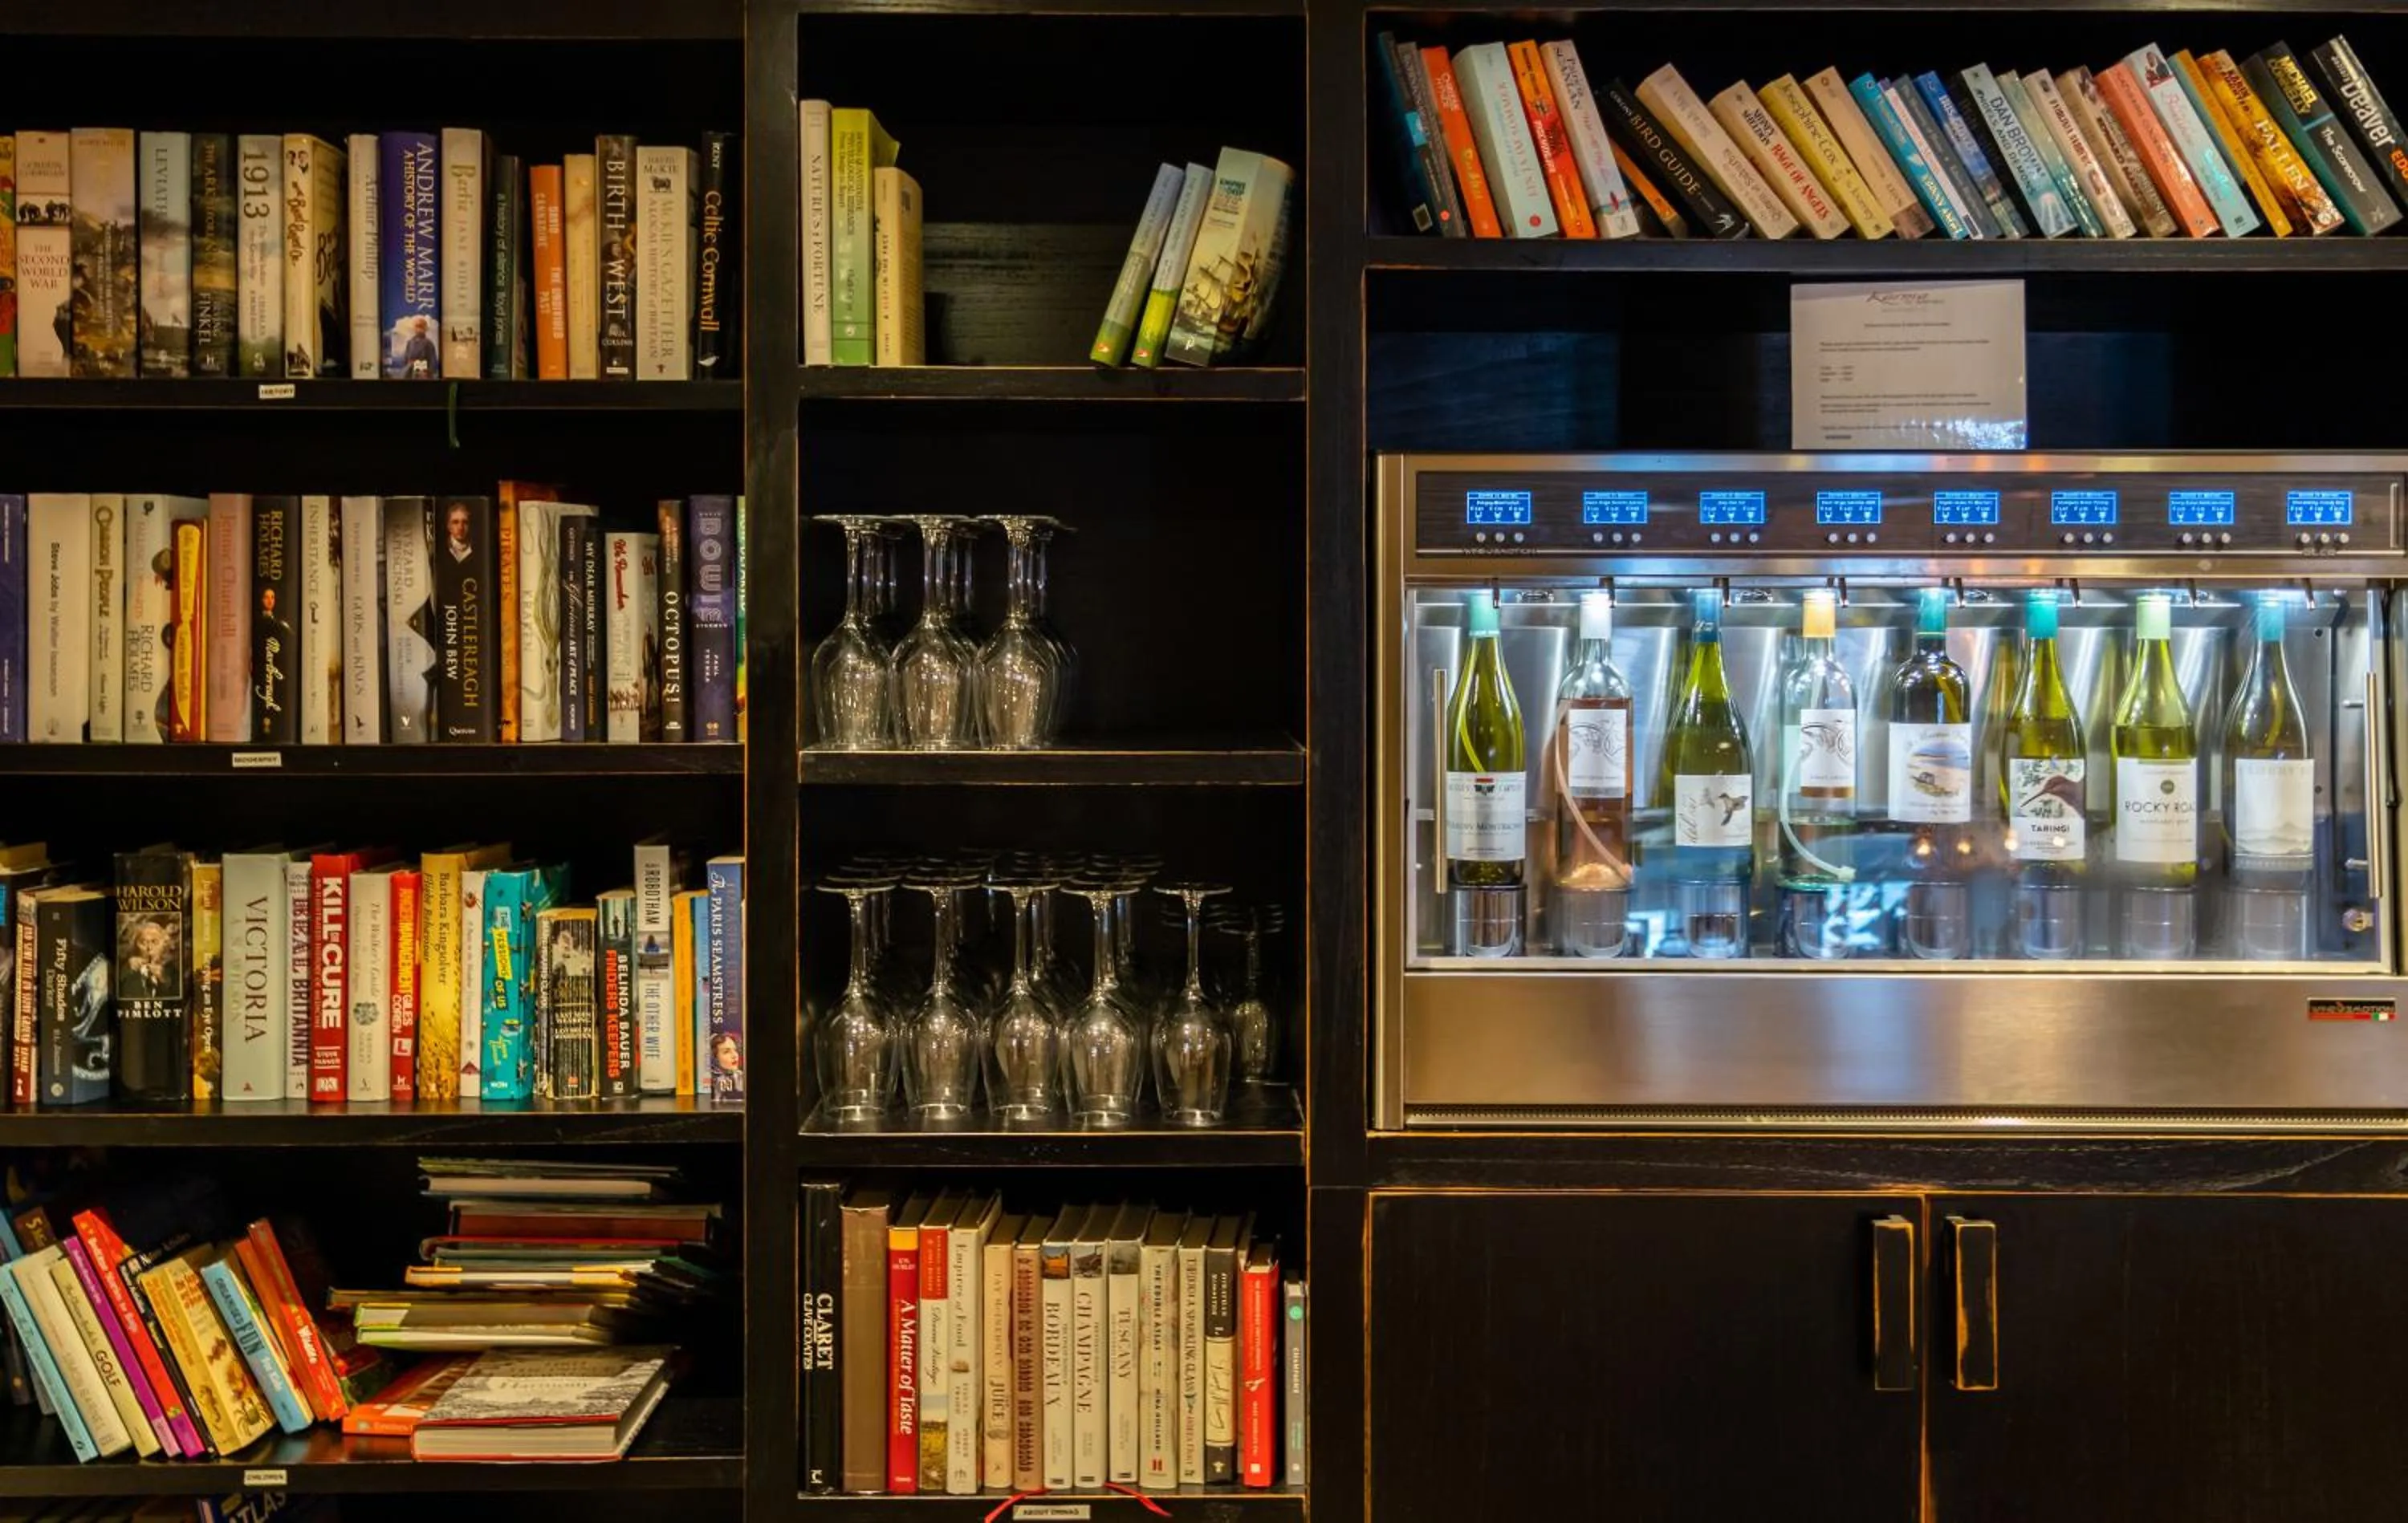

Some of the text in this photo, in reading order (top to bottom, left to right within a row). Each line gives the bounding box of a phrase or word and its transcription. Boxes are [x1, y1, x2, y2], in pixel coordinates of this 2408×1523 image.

[1987, 94, 2017, 129] DAN
[2265, 54, 2310, 119] CONNELLY
[2276, 52, 2318, 109] MICHAEL
[2319, 125, 2338, 147] The
[2338, 75, 2398, 154] Deaver
[243, 151, 270, 219] 1913
[1627, 111, 1702, 197] BIRD GUIDE
[2252, 114, 2310, 195] FALLEN
[451, 164, 477, 212] Bertie
[606, 159, 626, 229] BIRTH
[404, 150, 416, 303] A HISTORY OF THE WORLD
[417, 141, 436, 311] ANDREW MARR
[22, 267, 68, 278] WORLD
[30, 279, 58, 289] WAR
[606, 257, 626, 319] WEST
[700, 190, 724, 332] Celtic Cornwall
[197, 292, 211, 347] FINKEL
[50, 542, 60, 571] Steve
[258, 513, 270, 577] HOLMES
[270, 510, 283, 581] RICHARD
[307, 504, 319, 595] INHERITANCE
[500, 526, 511, 602] PIRATES
[49, 600, 59, 613] by
[50, 573, 61, 599] Jobs
[219, 565, 237, 638] Churchill
[585, 541, 596, 632] MY DEAR MURRAY
[443, 604, 458, 680] JOHN BEW
[462, 577, 479, 709] CASTLEREAGH
[522, 588, 534, 652] KRAKEN
[568, 639, 577, 658] ART
[663, 591, 681, 705] OCTOPUS!
[127, 630, 139, 692] HOLMES
[140, 624, 154, 692] RICHARD
[2031, 824, 2071, 833] TARINGI
[2125, 800, 2169, 814] ROCKY
[116, 885, 183, 899] HAROLD
[116, 897, 181, 911] WILSON
[321, 876, 344, 1029] KILL CURE
[435, 872, 450, 985] Barbara Kingsolver
[494, 932, 511, 978] VERSIONS
[711, 896, 723, 1024] PARIS SEAMSTRESS
[45, 969, 56, 1009] Darker
[55, 937, 67, 1022] Fifty Shades
[244, 895, 269, 1044] VICTORIA
[494, 980, 505, 993] OF
[496, 995, 506, 1008] US
[117, 1009, 183, 1019] PIMLOTT
[132, 1000, 163, 1009] BEN
[202, 1007, 213, 1024] Eye
[291, 978, 310, 1067] BRITANNIA
[392, 994, 401, 1034] COREN
[401, 995, 413, 1026] GILES
[605, 949, 620, 1078] FINDERS KEEPERS
[617, 954, 630, 1070] BELINDA BAUER
[646, 983, 661, 1059] THE OTHER WIFE
[233, 1319, 266, 1358] FUN
[803, 1293, 813, 1371] CLIVE COATES
[816, 1293, 834, 1371] CLARET
[1044, 1302, 1061, 1409] BORDEAUX
[1076, 1292, 1093, 1414] CHAMPAGNE
[1117, 1307, 1131, 1383] TUSCANY
[92, 1346, 124, 1391] GOLF
[898, 1299, 916, 1436] A Matter of Taste
[990, 1379, 1006, 1420] JUICE
